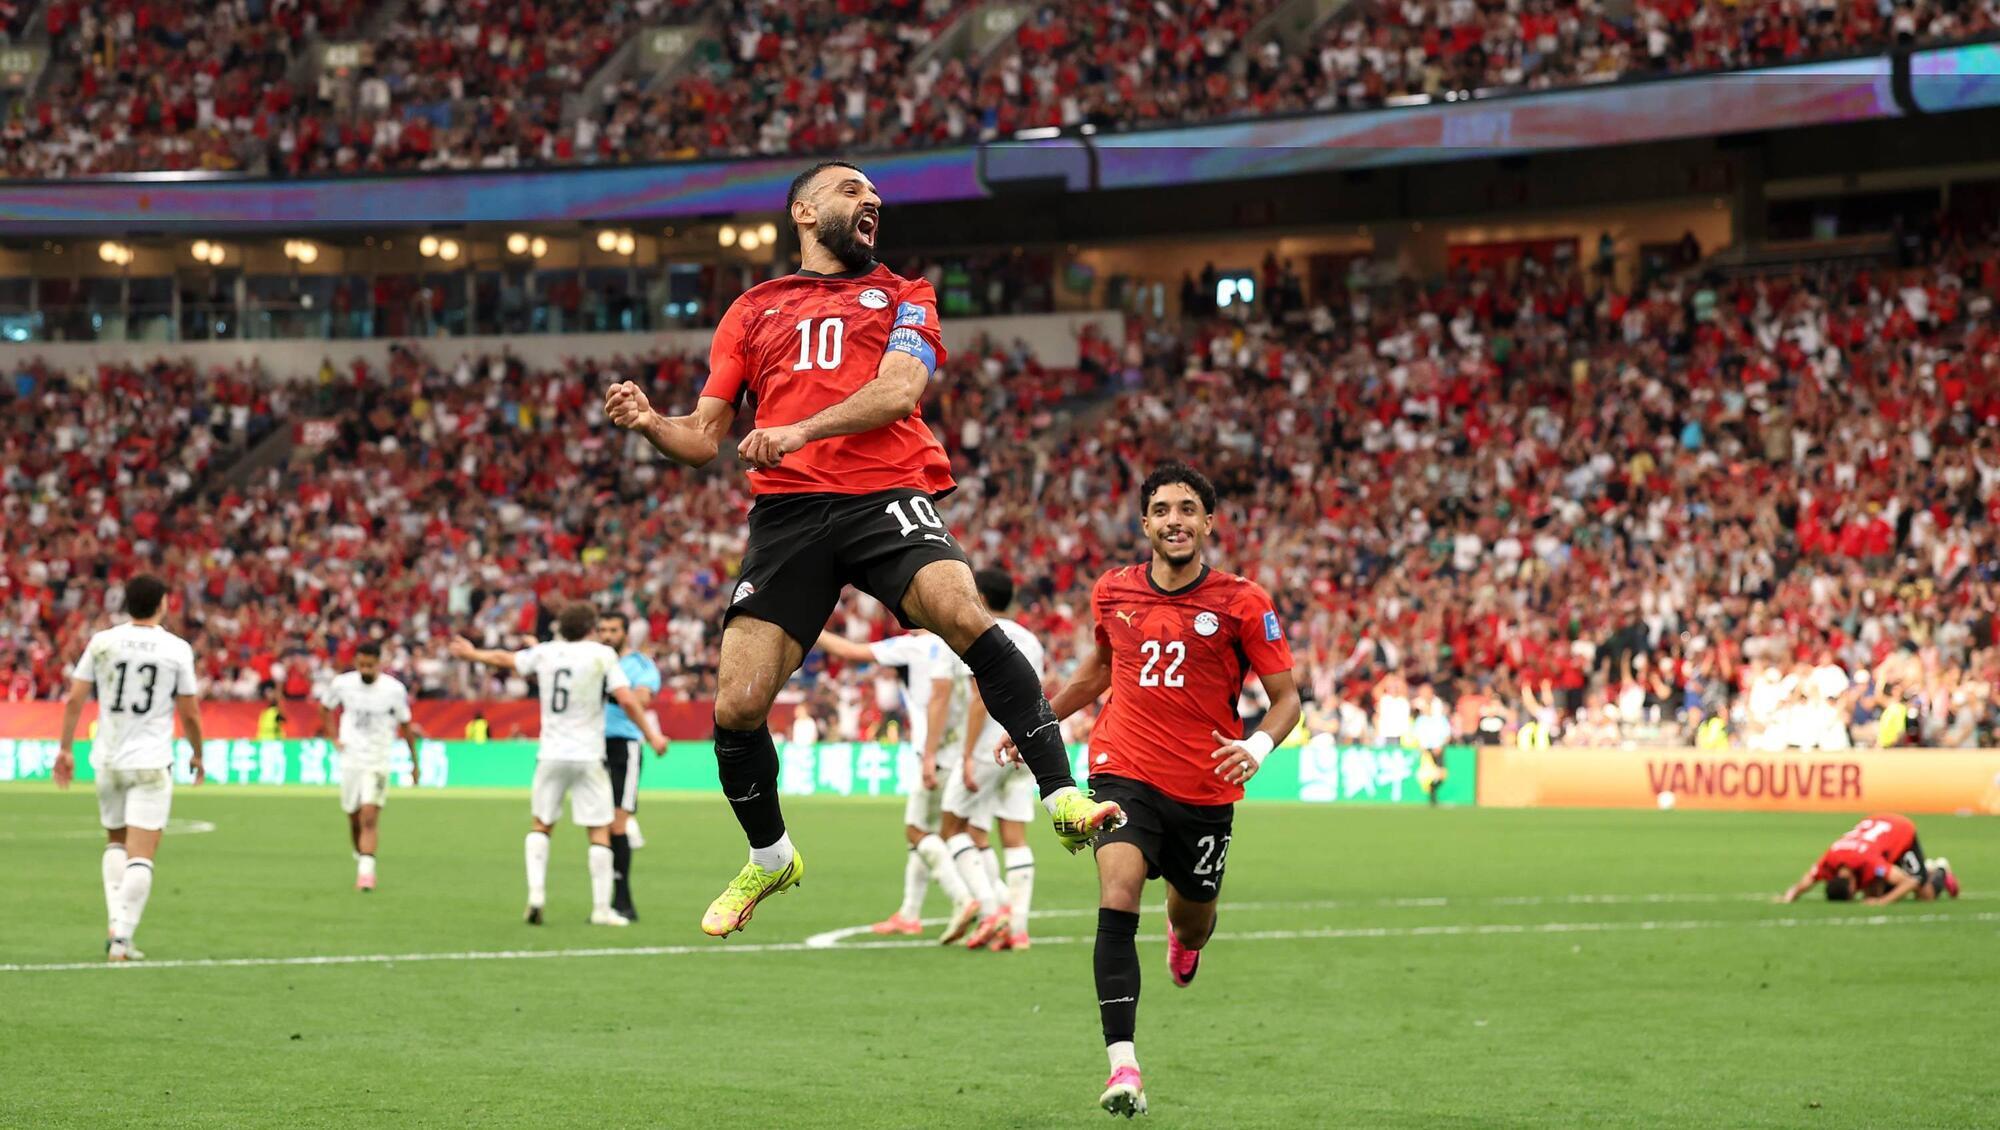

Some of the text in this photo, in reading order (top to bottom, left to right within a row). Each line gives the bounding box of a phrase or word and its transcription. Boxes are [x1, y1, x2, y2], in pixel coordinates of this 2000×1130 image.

[793, 317, 844, 371] 10
[885, 495, 943, 537] 10
[1139, 640, 1186, 687] 22
[110, 660, 158, 714] 13
[551, 668, 572, 713] 6
[1648, 761, 1861, 798] VANCOUVER
